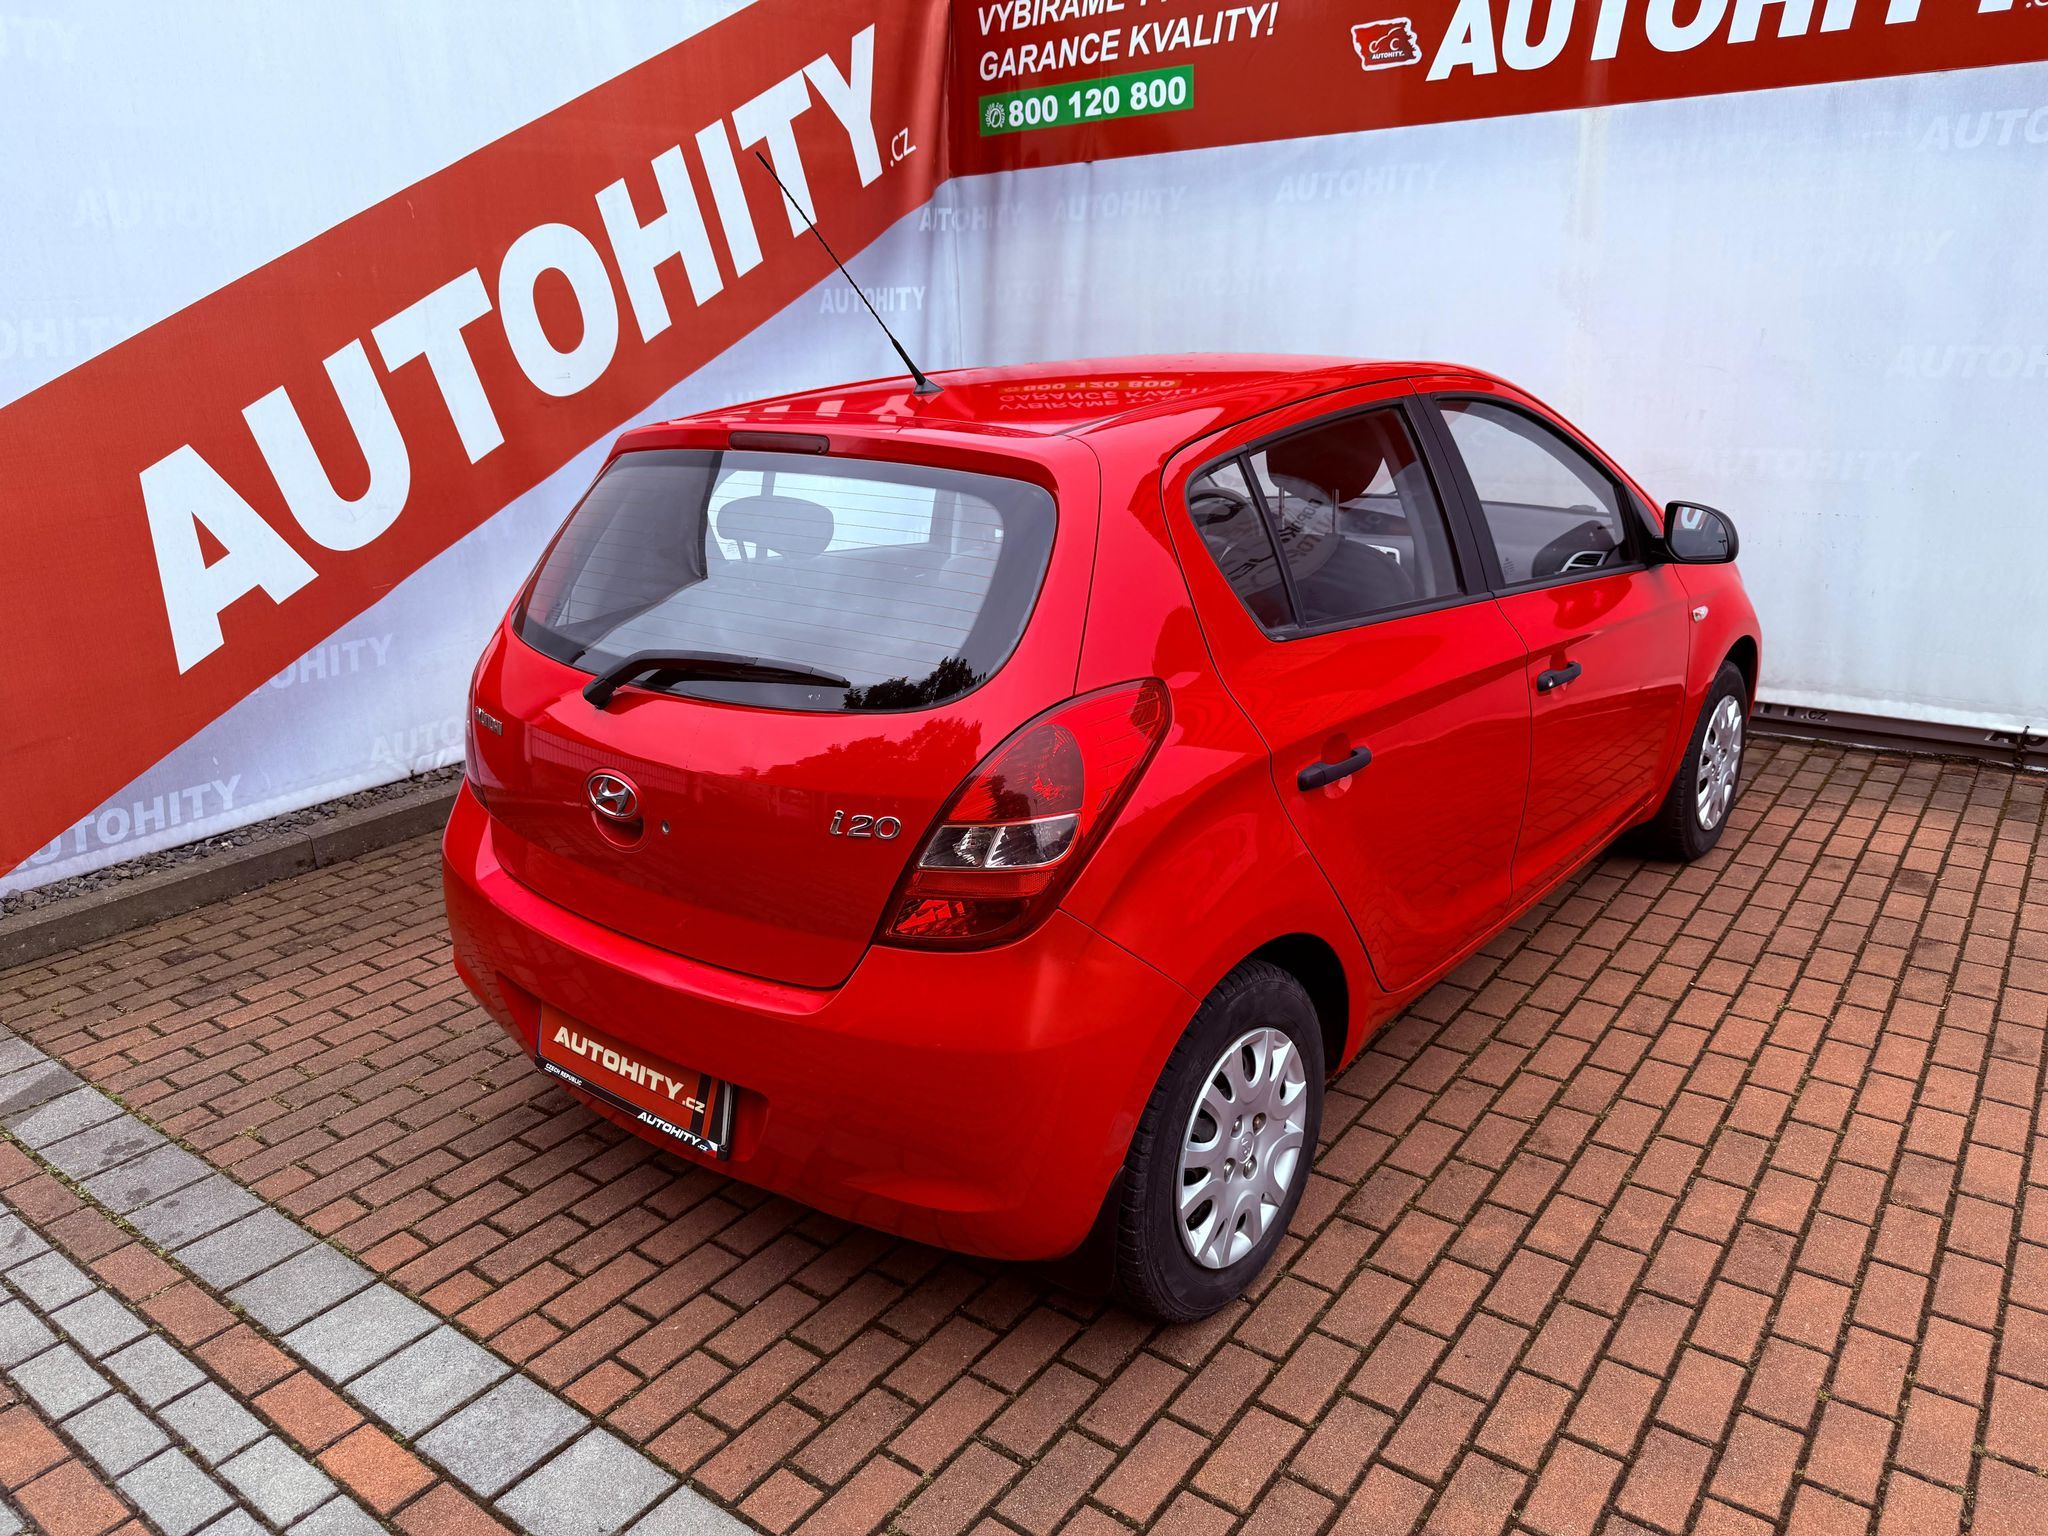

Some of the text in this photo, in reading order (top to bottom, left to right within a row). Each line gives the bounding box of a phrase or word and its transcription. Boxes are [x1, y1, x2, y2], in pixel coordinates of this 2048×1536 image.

[978, 2, 1279, 81] GARANCE KVALITY!
[1008, 76, 1187, 127] 800 120 800
[819, 286, 926, 314] AUTOHITY
[829, 809, 902, 840] i20
